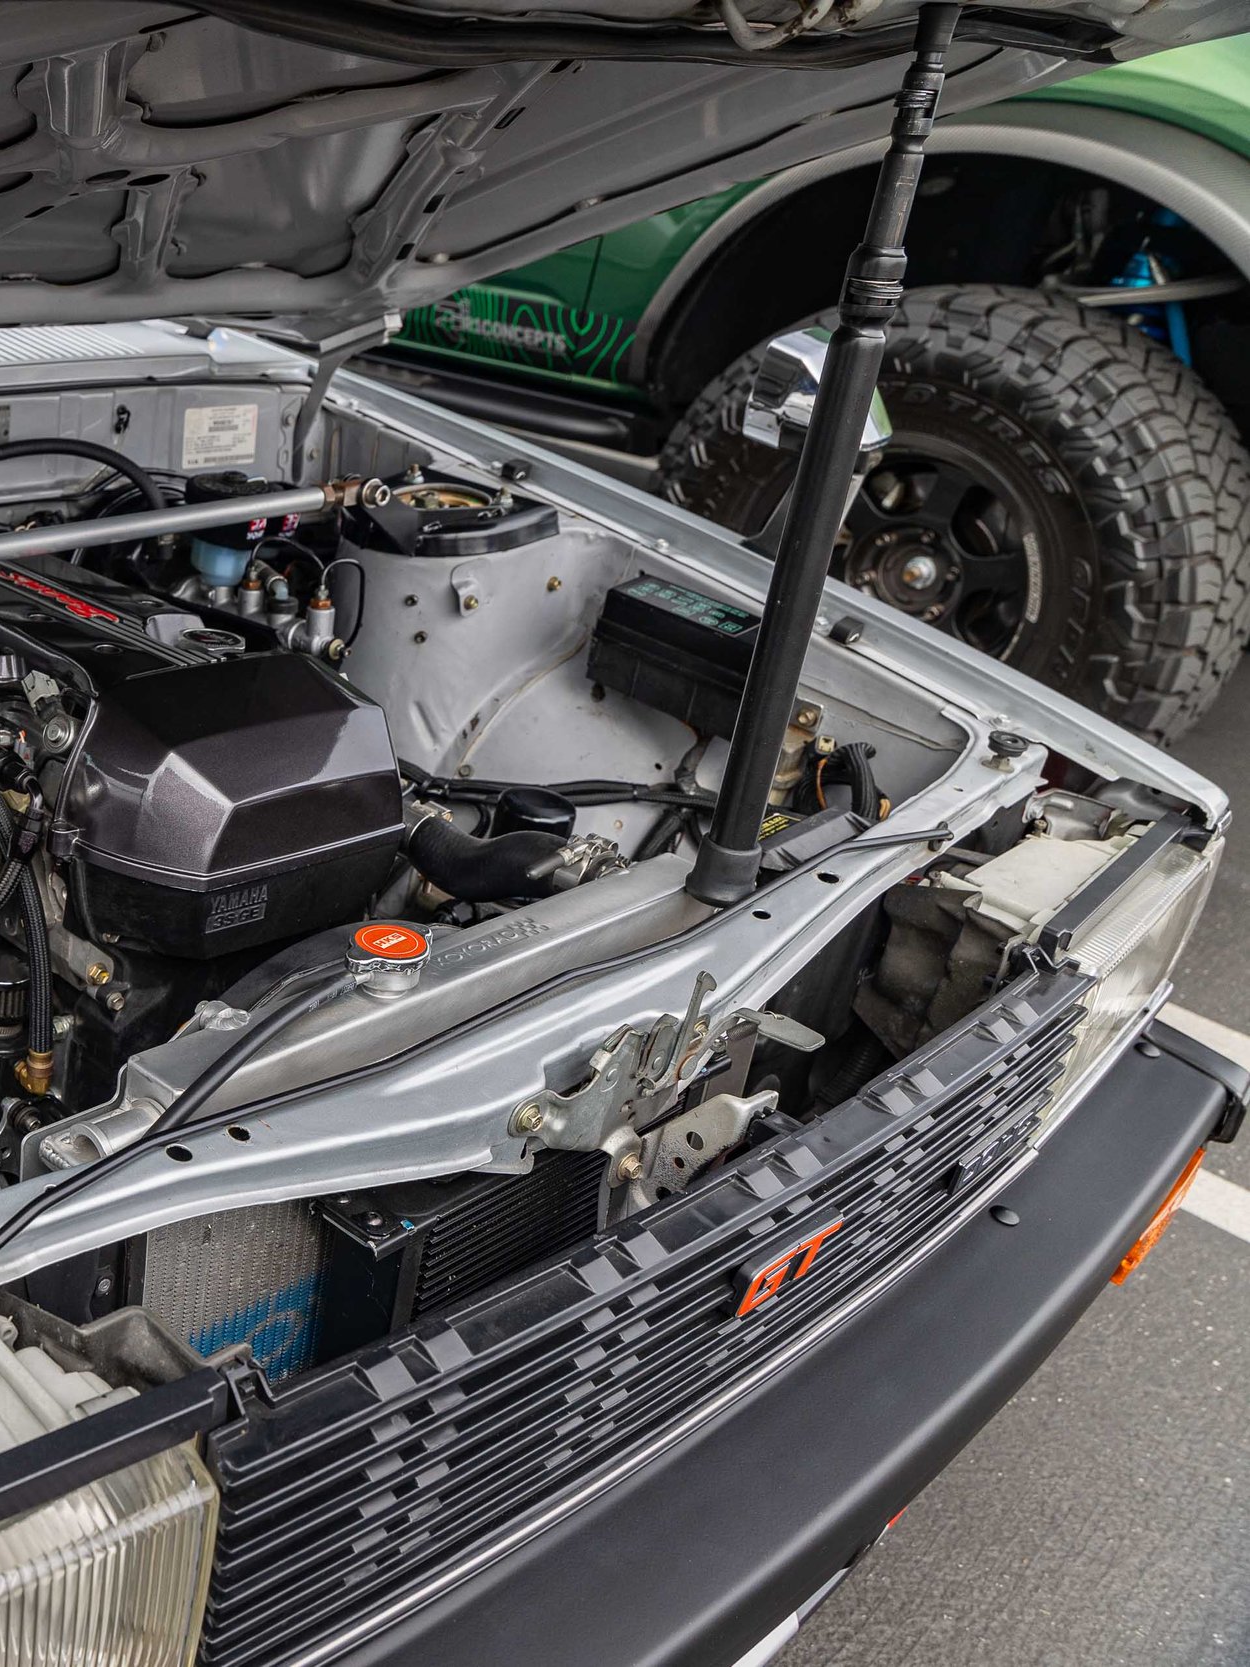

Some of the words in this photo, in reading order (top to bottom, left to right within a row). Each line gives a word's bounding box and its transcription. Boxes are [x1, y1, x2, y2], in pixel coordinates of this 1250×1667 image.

[210, 884, 268, 914] YAMAHA
[373, 932, 404, 948] HKS
[735, 1218, 844, 1317] GT
